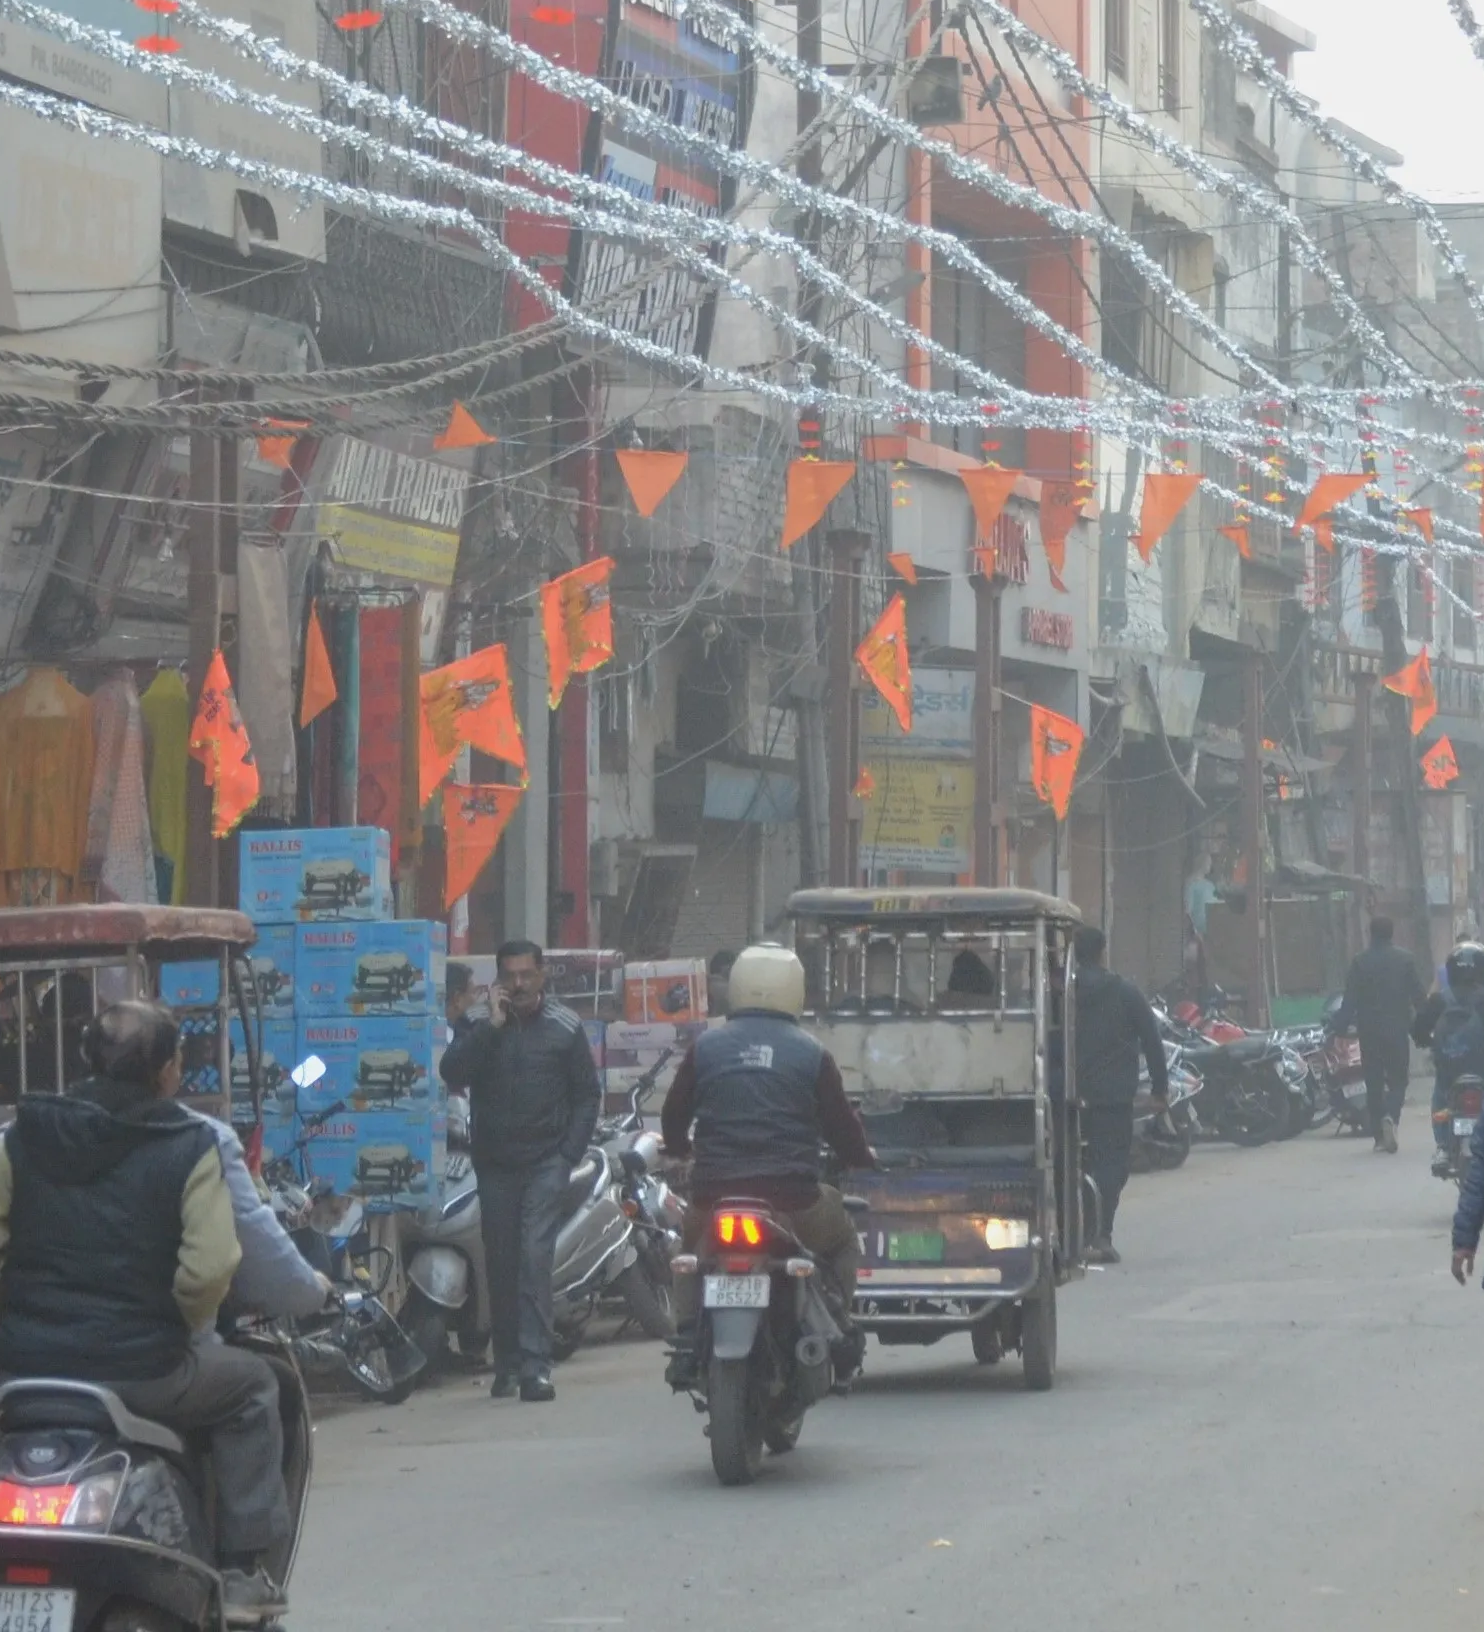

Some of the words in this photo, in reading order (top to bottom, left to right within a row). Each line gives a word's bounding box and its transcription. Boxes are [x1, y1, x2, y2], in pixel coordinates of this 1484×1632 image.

[326, 437, 392, 509] AMAN
[390, 452, 469, 528] TRADERS
[306, 1123, 357, 1136] LLIS
